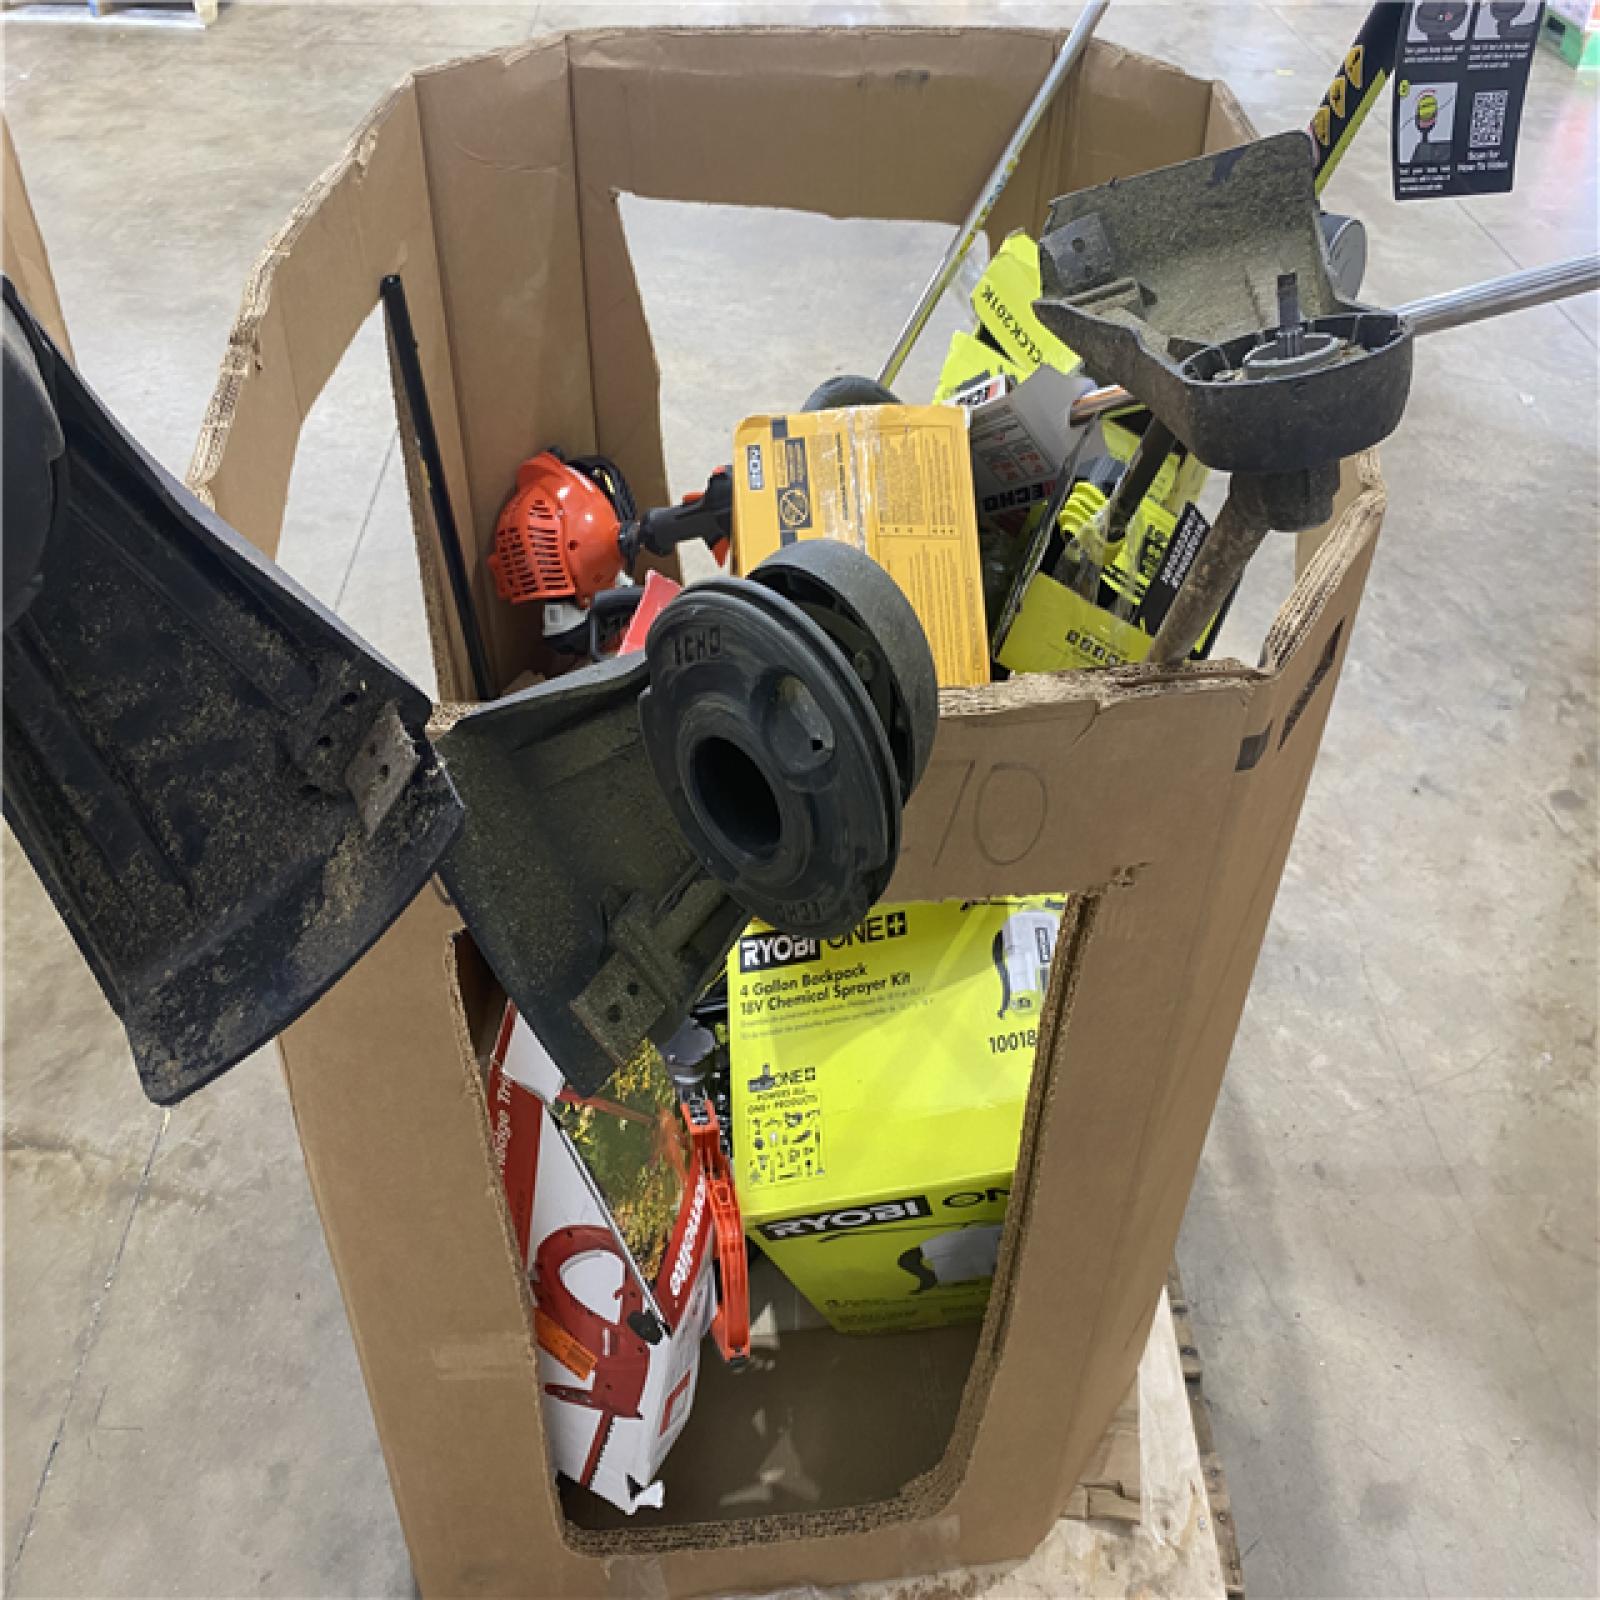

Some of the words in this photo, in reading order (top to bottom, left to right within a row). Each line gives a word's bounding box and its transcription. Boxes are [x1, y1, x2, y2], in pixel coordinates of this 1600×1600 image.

[981, 284, 1042, 362] CLCK201K
[741, 935, 817, 966] RYOBI
[739, 984, 748, 996] 4
[752, 979, 798, 997] Gallon
[802, 961, 866, 988] Backpack
[740, 1001, 762, 1015] 18V
[767, 986, 830, 1011] Chemical
[833, 978, 887, 1000] Sprayer
[889, 971, 911, 987] Kit
[765, 1200, 920, 1237] RYOBI
